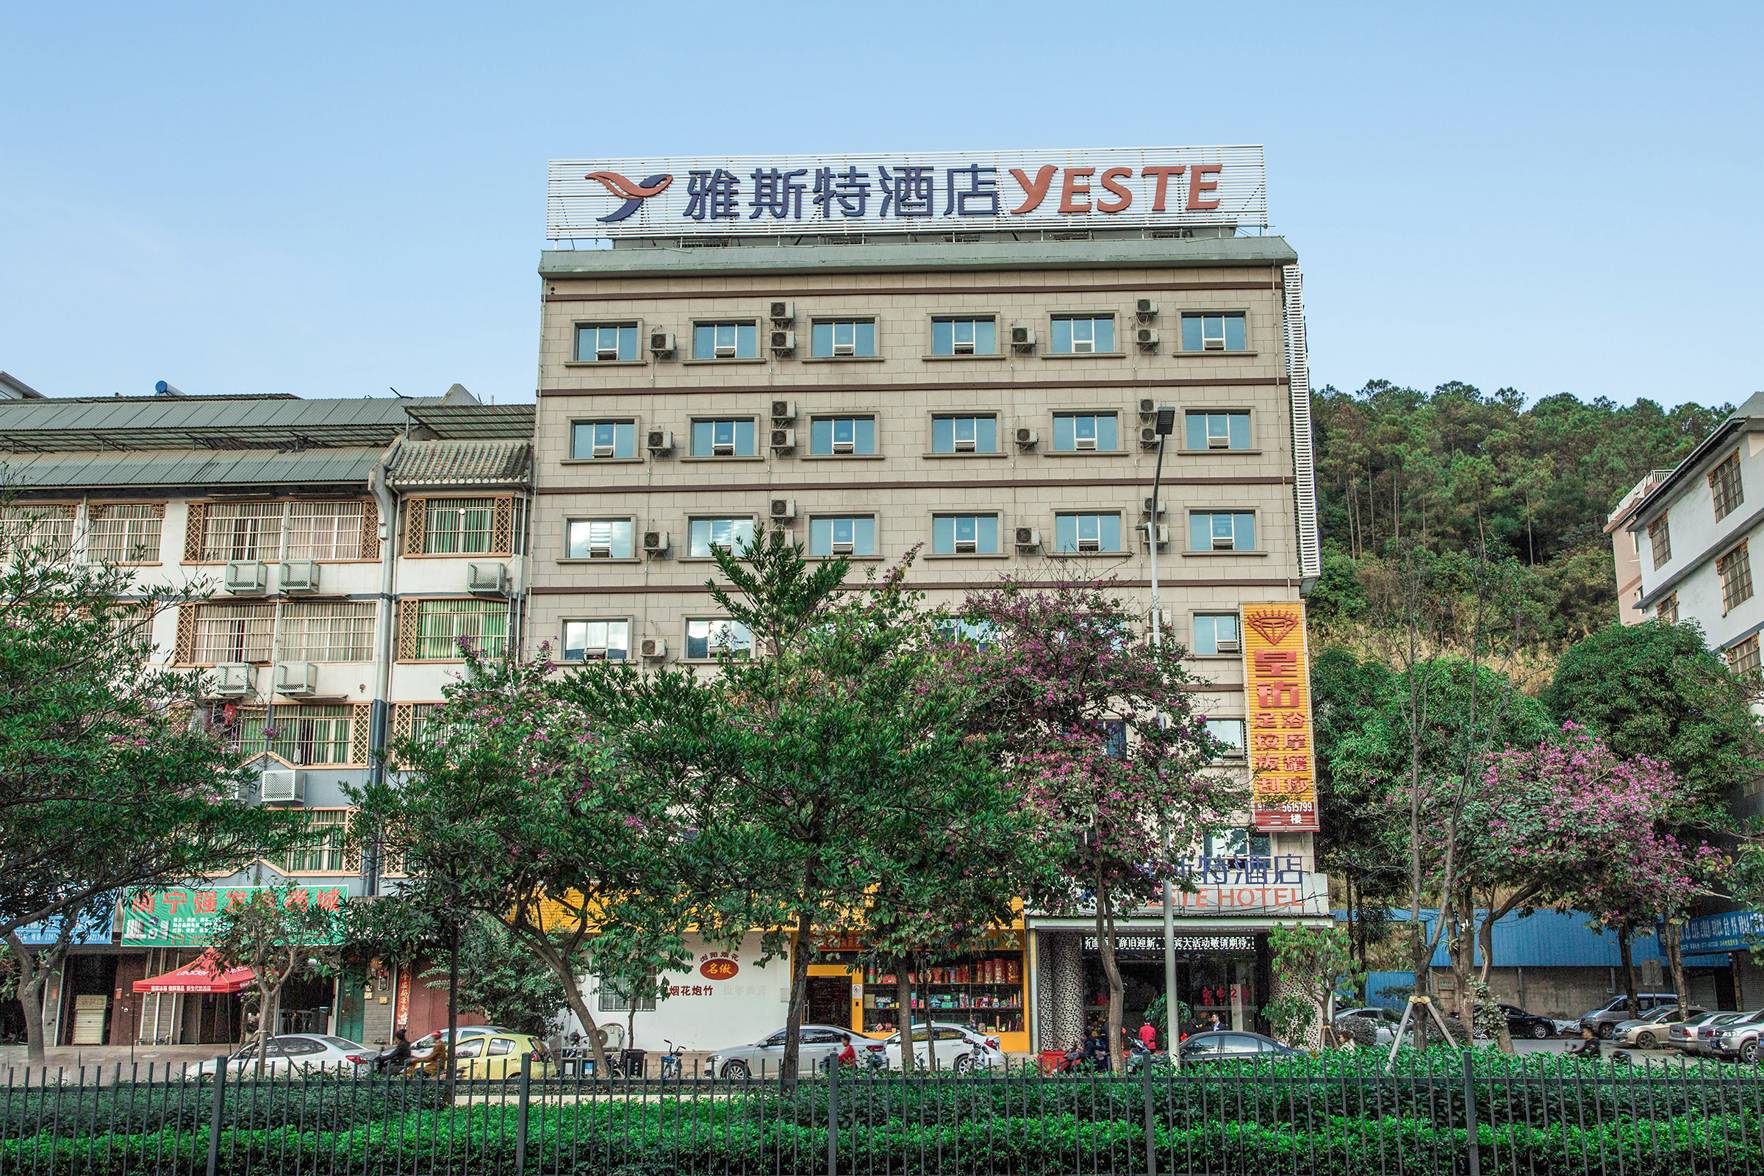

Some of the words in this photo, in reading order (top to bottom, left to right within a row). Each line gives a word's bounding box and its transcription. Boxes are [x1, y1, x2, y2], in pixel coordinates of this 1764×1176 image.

[683, 164, 999, 219] 雅斯特酒店
[1009, 164, 1223, 214] YESTE
[1254, 711, 1305, 728] 足浴
[1255, 733, 1307, 750] 按摩
[1256, 754, 1308, 772] 拔罐
[1257, 776, 1308, 794] 刮痧
[1282, 801, 1312, 813] 5615799
[1270, 813, 1303, 824] 二楼
[1132, 853, 1303, 885] 特酒店
[1218, 887, 1306, 907] HOTEL
[700, 951, 740, 963] 浏阳烟花
